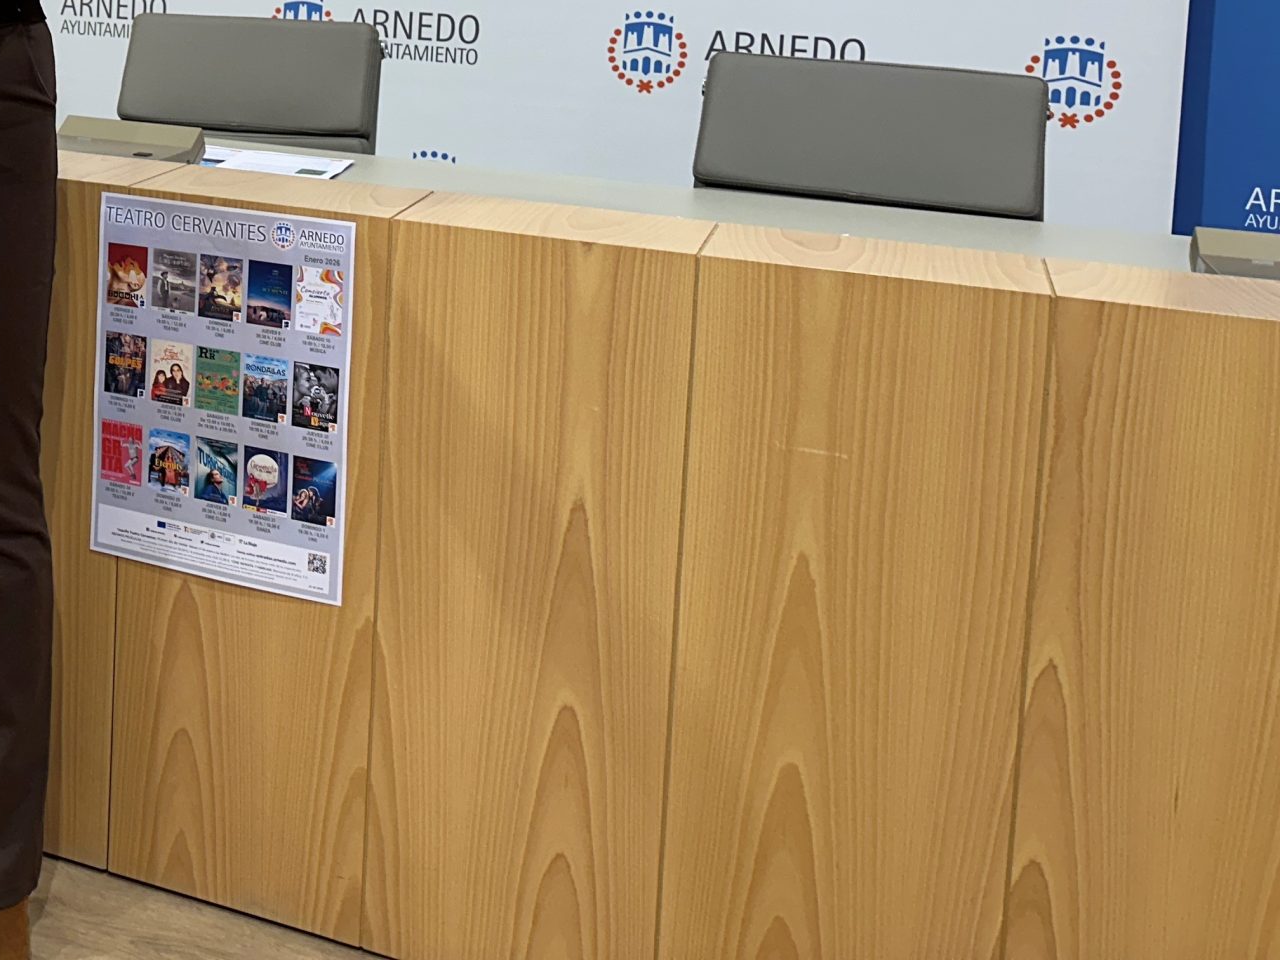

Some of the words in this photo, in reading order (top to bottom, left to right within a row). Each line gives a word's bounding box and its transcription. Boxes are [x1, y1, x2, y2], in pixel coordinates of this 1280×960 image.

[60, 19, 130, 39] AYUNTAMI
[383, 42, 478, 66] NTAMIENTO
[106, 205, 166, 229] TEATRO
[171, 214, 267, 242] CERVANTES
[300, 229, 345, 246] ARNEDO
[300, 241, 344, 253] AYUNTAMIENTO
[304, 254, 324, 265] Enero
